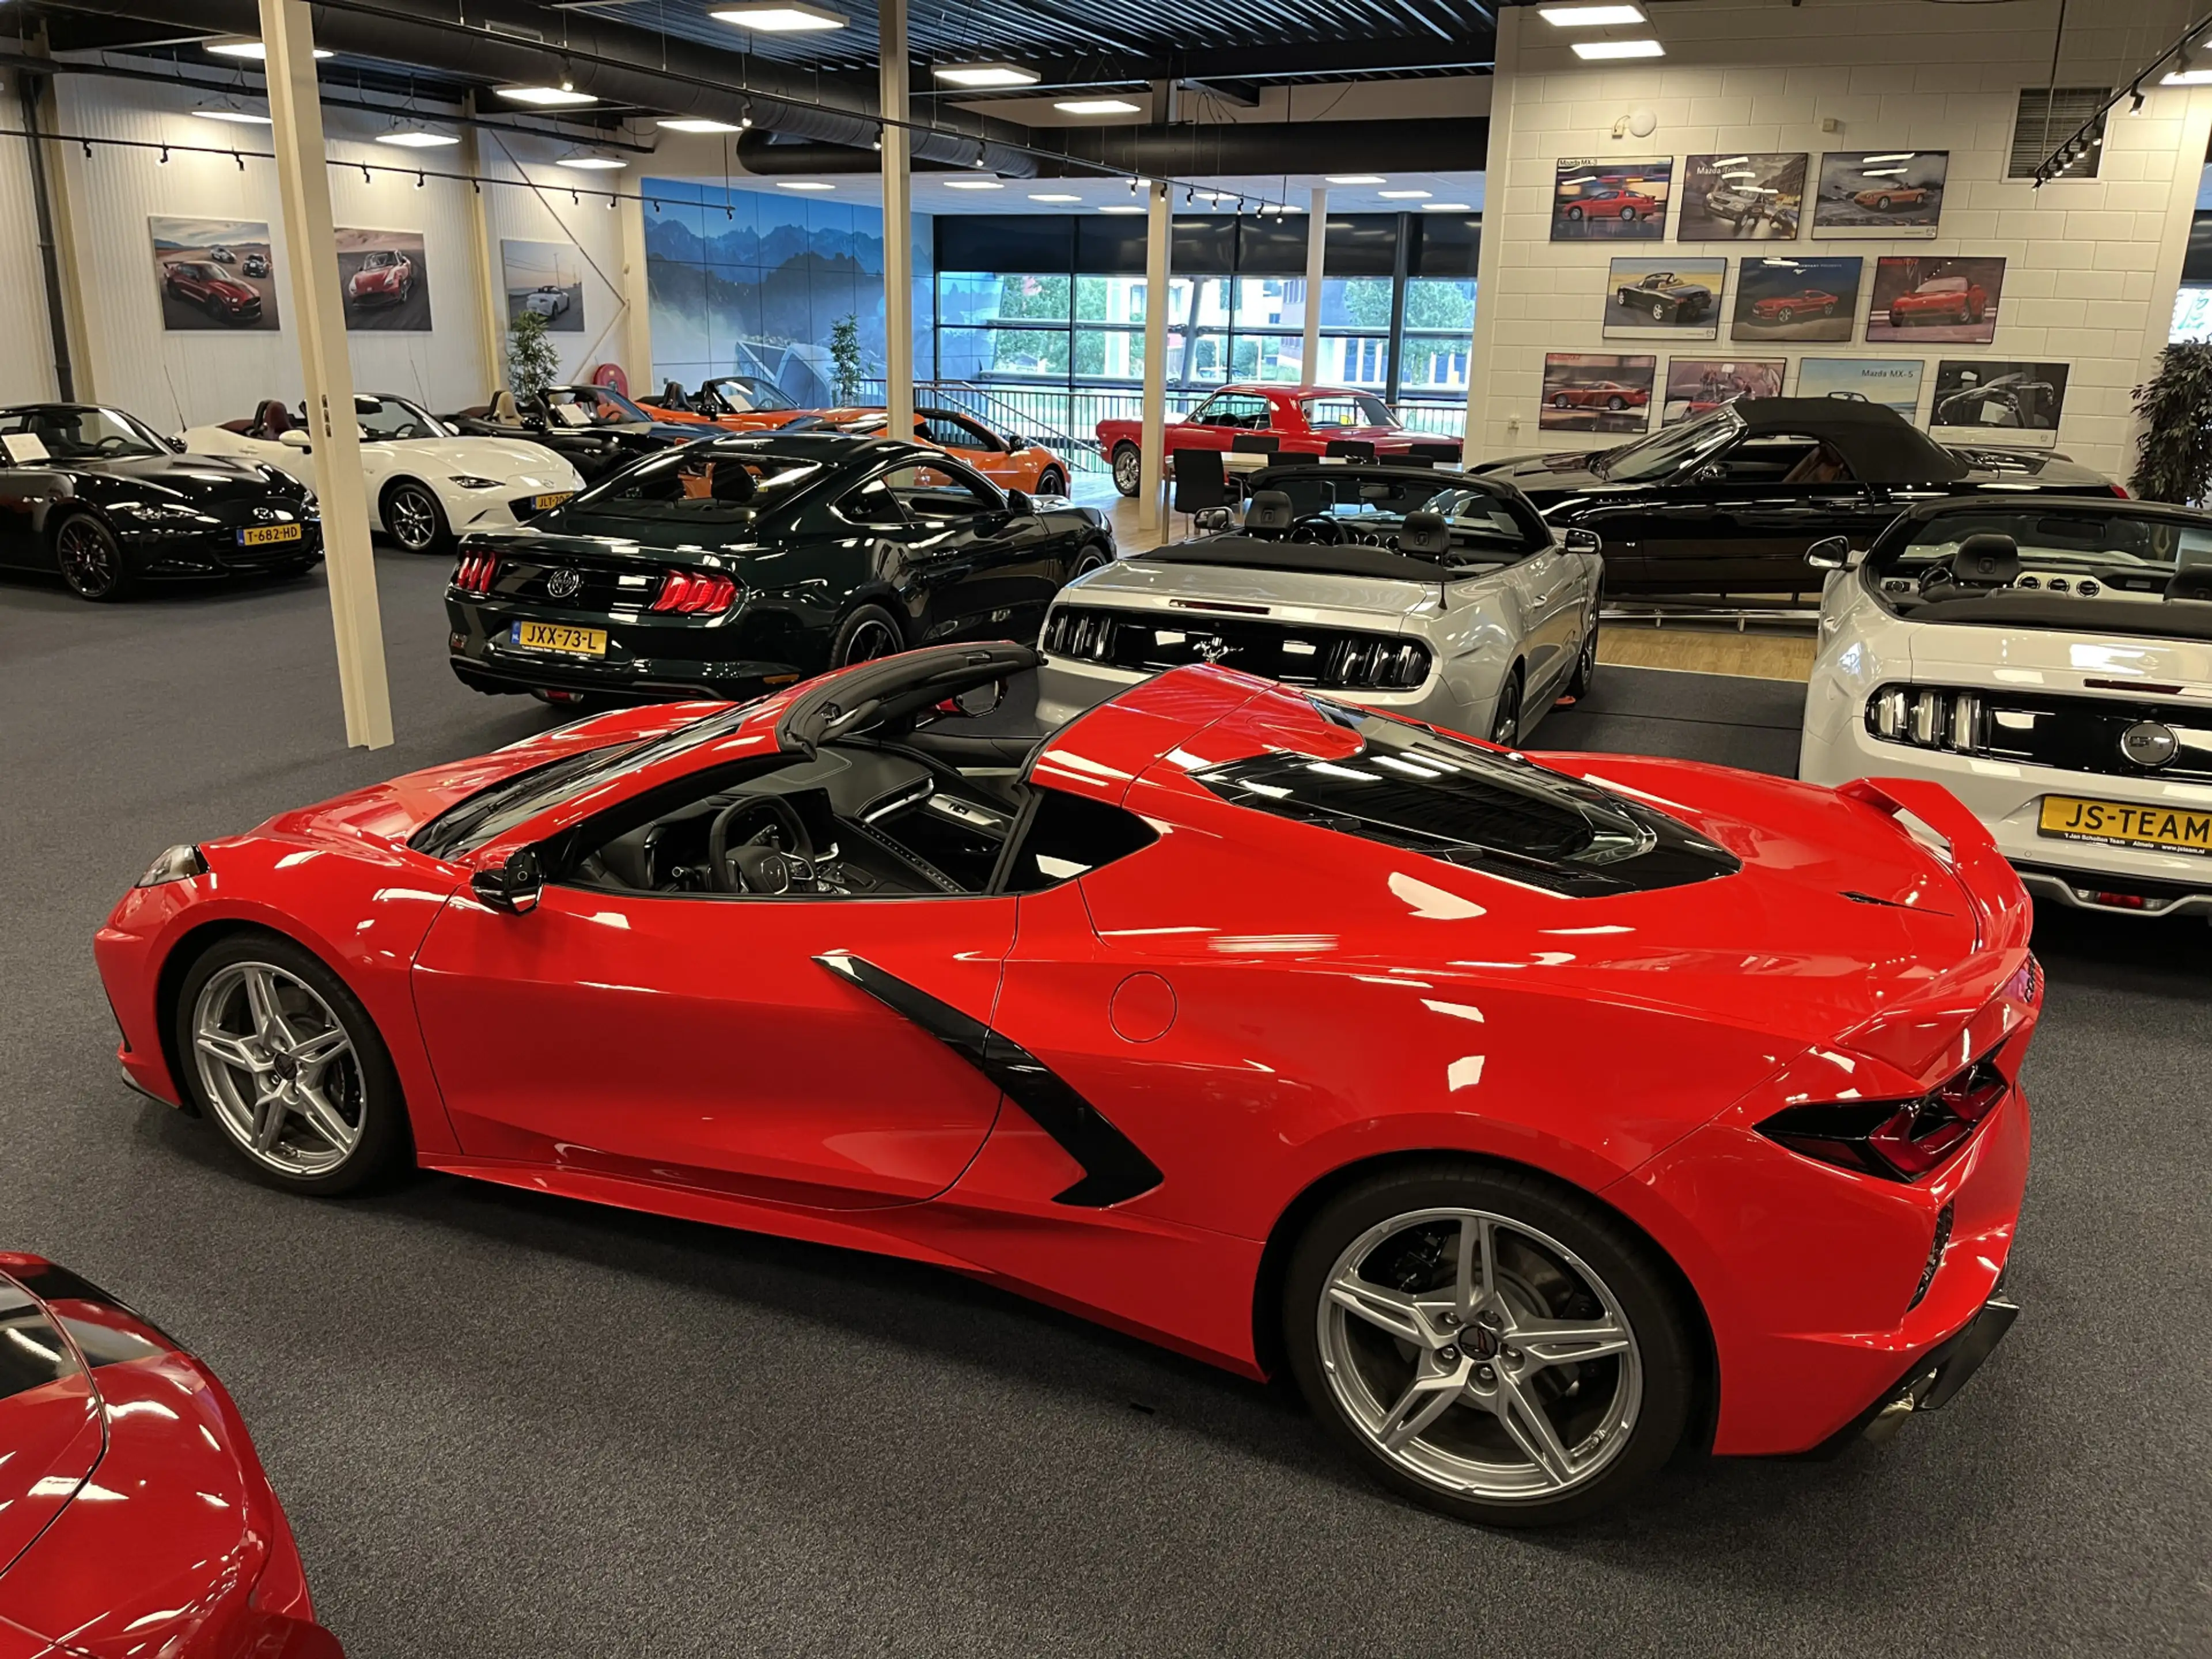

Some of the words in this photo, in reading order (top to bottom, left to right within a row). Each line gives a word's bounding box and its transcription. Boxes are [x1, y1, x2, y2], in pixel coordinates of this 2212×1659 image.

[1862, 369, 1887, 377] Mazda
[1890, 370, 1914, 378] MX-5
[247, 527, 297, 543] T-682-HD
[527, 625, 596, 650] JXX-73-L
[2066, 804, 2211, 843] JS-TEAM
[2109, 837, 2126, 845] Team
